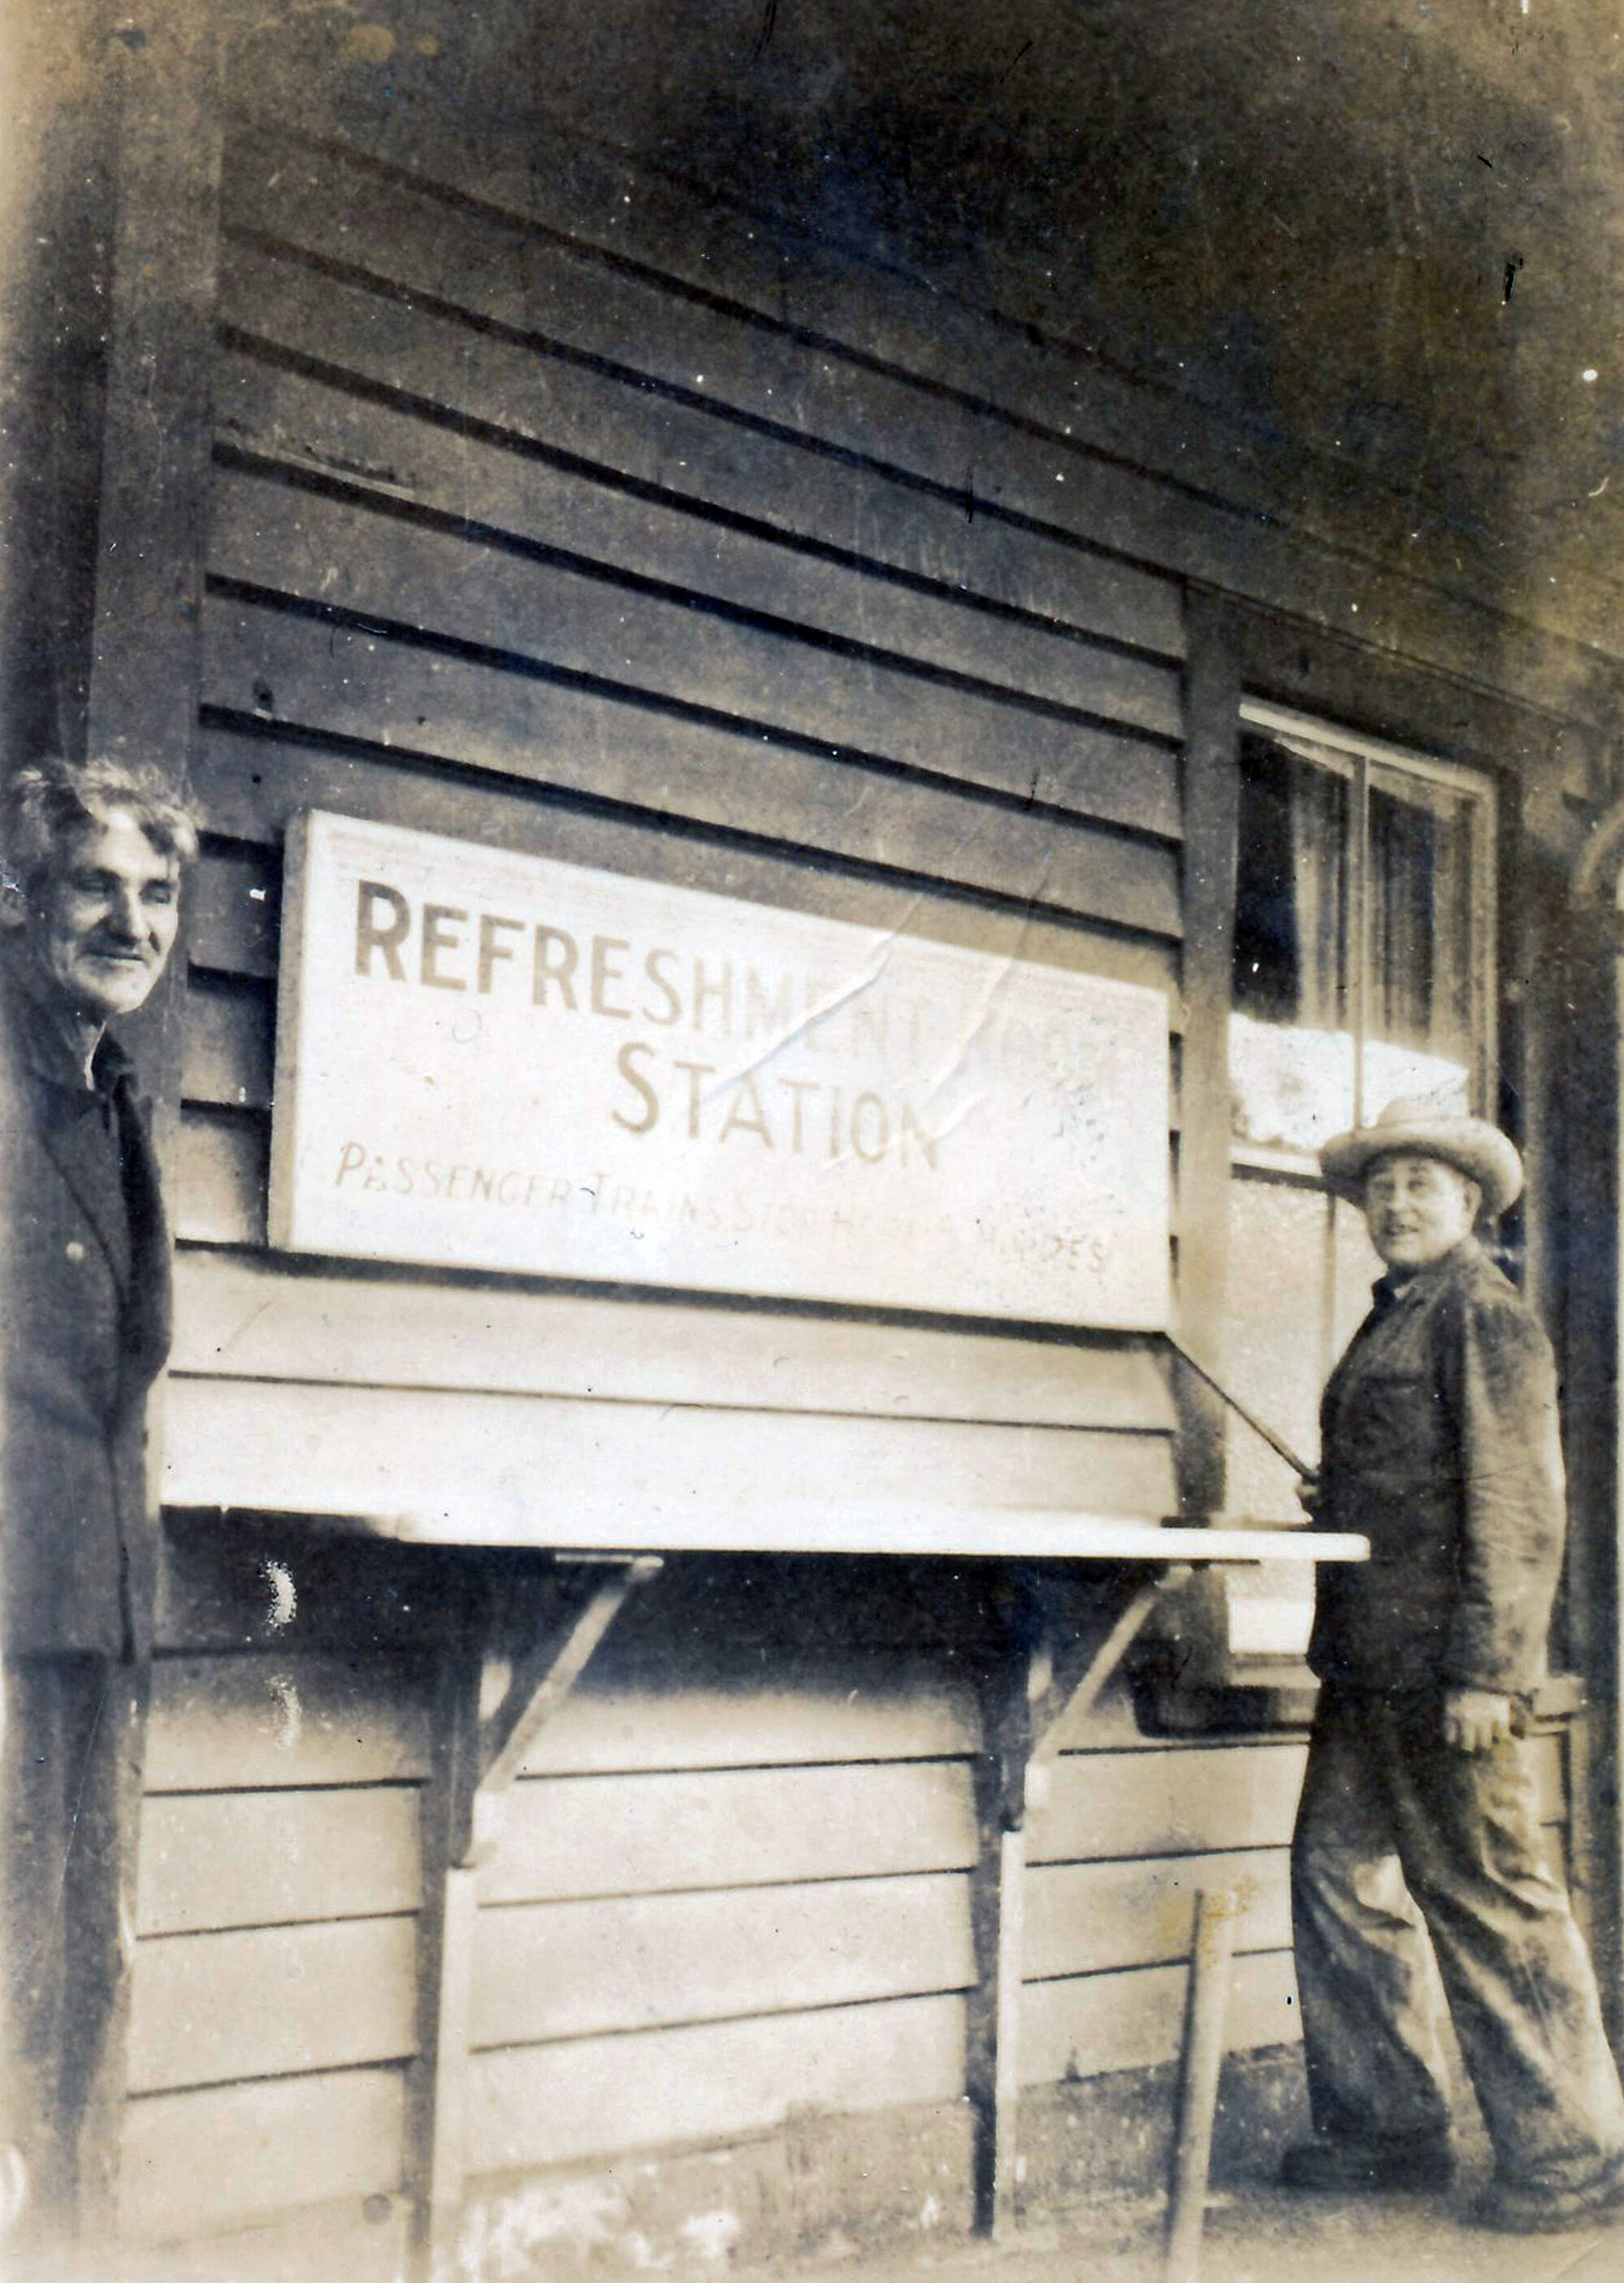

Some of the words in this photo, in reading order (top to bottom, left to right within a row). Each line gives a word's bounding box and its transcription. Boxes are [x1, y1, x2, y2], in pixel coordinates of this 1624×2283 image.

[354, 877, 933, 1065] REFRESHMENT
[608, 1039, 941, 1171] STATION
[333, 1141, 574, 1206] PASSENGER
